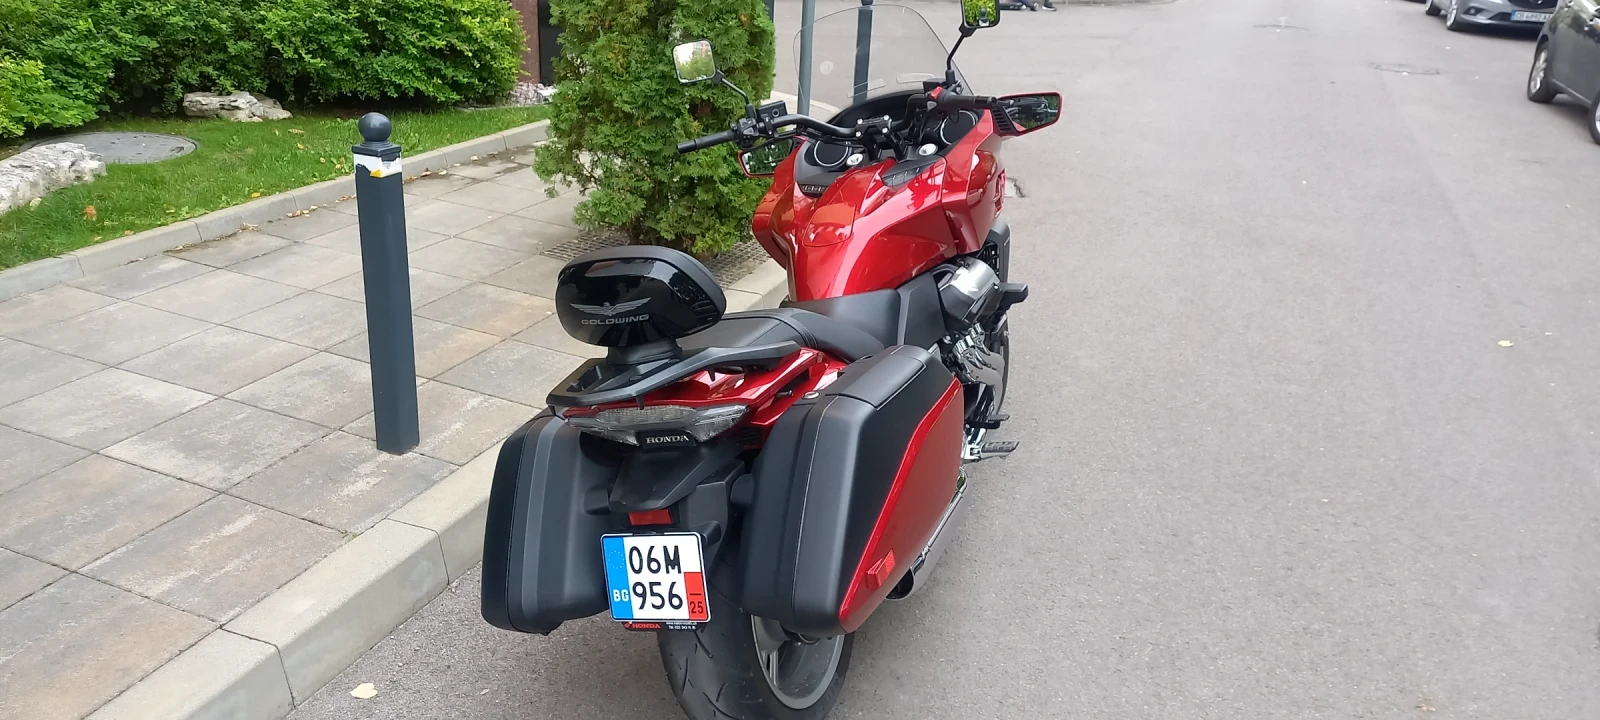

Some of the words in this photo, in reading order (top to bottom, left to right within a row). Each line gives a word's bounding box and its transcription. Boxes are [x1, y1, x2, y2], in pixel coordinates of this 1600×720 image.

[581, 314, 650, 325] GOLDWING
[645, 435, 689, 444] HONDA
[628, 545, 682, 575] 06M
[612, 589, 630, 602] BG
[632, 581, 684, 610] 956
[690, 601, 704, 614] 25
